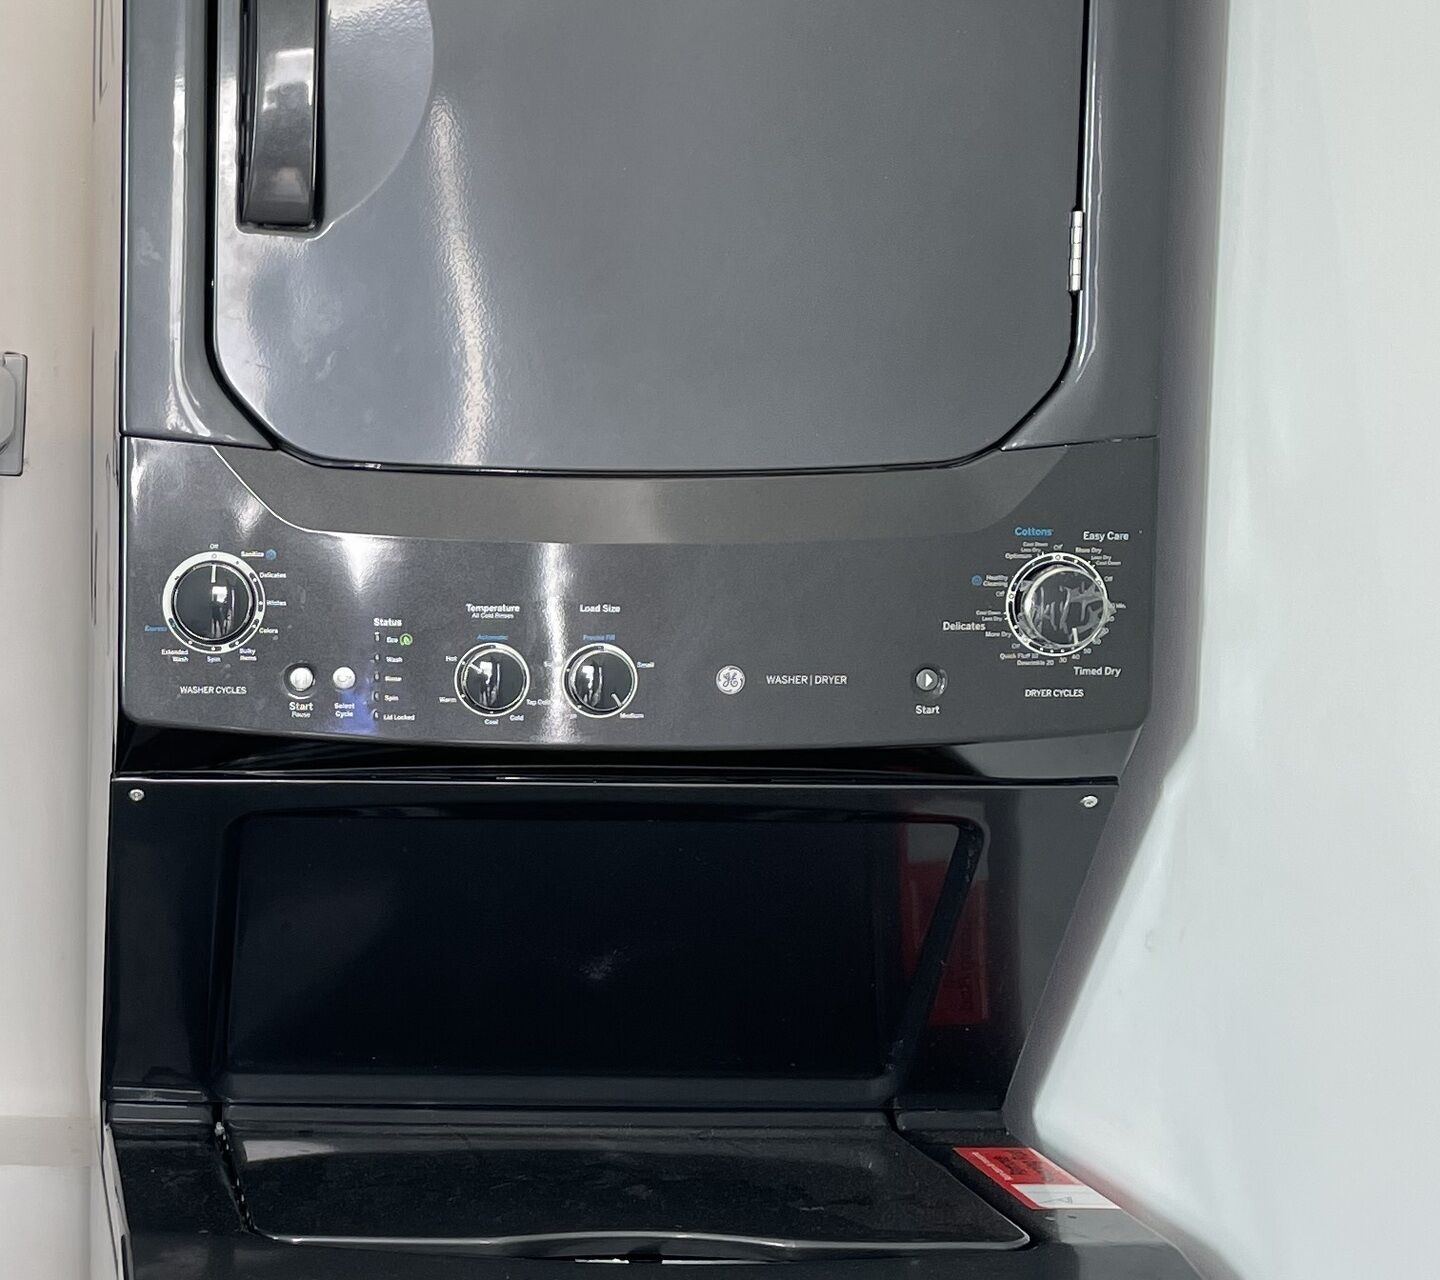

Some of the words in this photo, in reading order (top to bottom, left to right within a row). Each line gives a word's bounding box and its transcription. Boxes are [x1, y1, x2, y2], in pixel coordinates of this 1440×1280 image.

[1015, 527, 1052, 536] Cottons
[1083, 532, 1105, 541] Easy
[1107, 532, 1129, 540] Care
[466, 604, 520, 613] Temperature
[374, 618, 402, 627] Status
[943, 622, 986, 631] Delicates
[1074, 667, 1102, 675] Timed
[1105, 667, 1121, 677] Dry
[766, 675, 808, 684] WASHER
[815, 676, 847, 685] DRYER
[180, 686, 215, 694] WASHER
[216, 686, 247, 694] CYCLES
[289, 702, 313, 711] Start
[915, 705, 940, 714] Start
